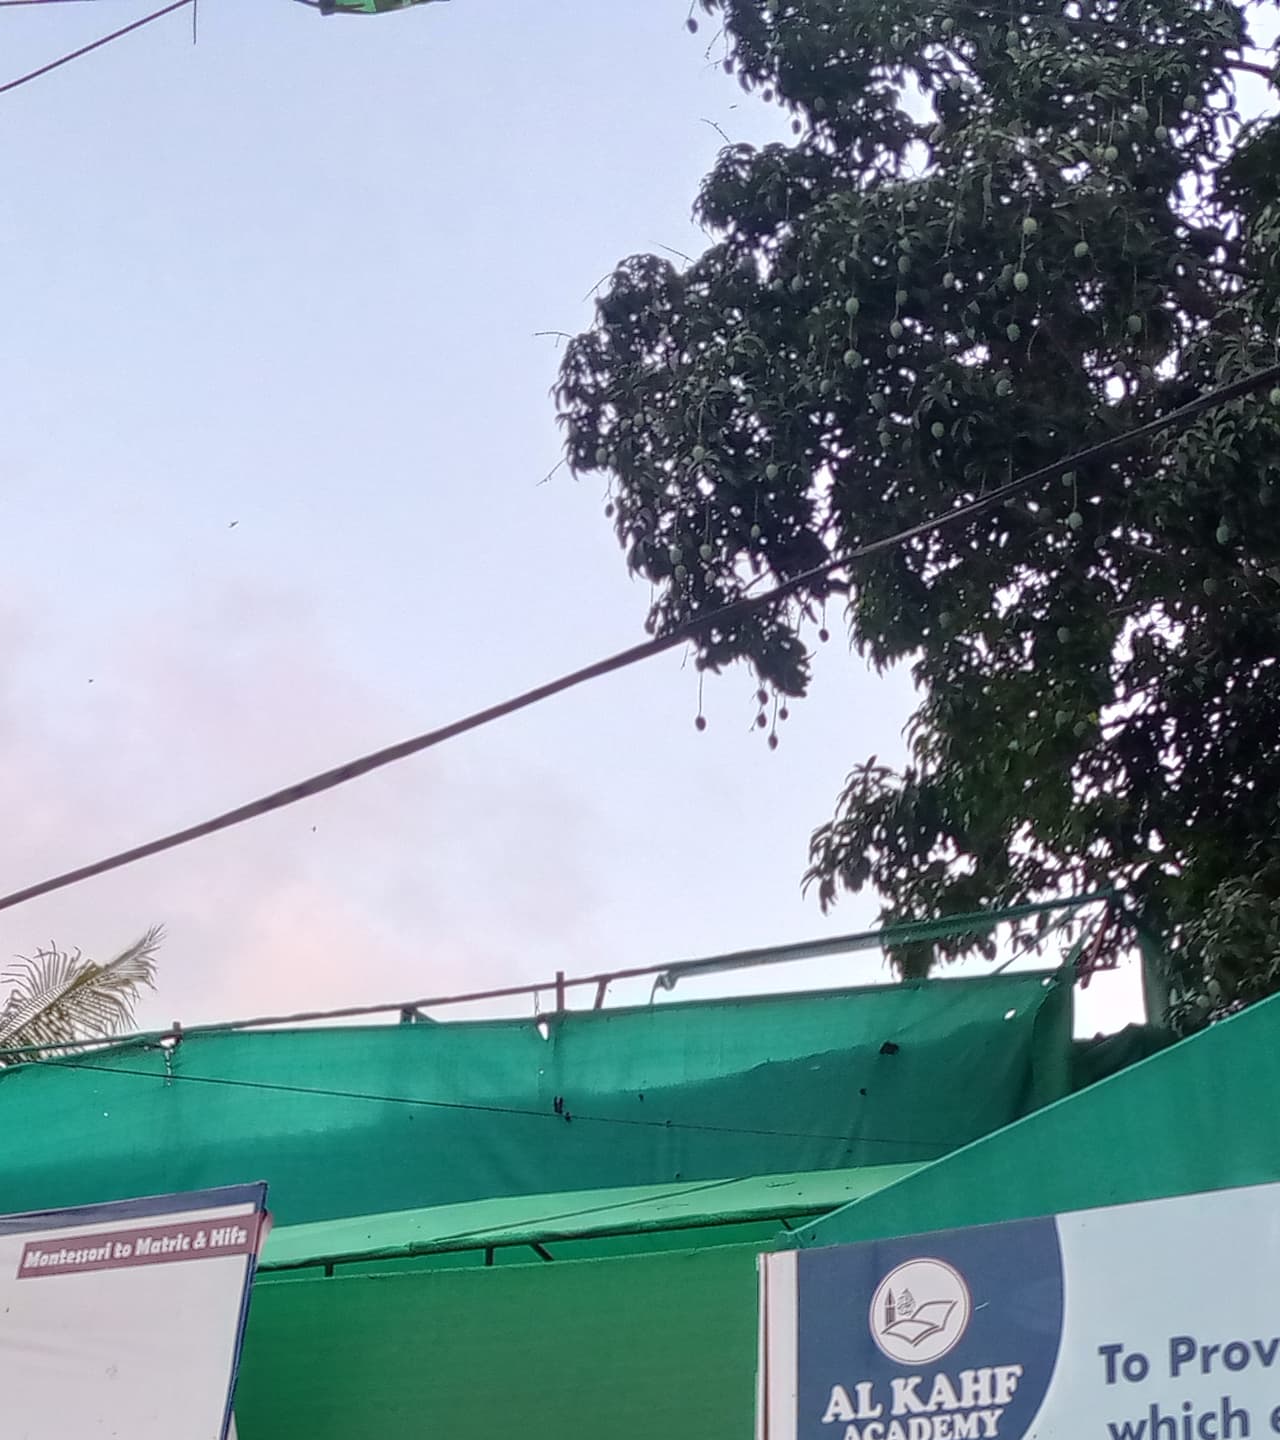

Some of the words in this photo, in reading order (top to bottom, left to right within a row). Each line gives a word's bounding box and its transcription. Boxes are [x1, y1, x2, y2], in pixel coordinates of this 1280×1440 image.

[22, 1242, 112, 1269] Montessori
[114, 1243, 132, 1258] to
[134, 1233, 191, 1256] Matric
[193, 1230, 207, 1249] &
[210, 1225, 248, 1248] Hifz
[1098, 1342, 1150, 1385] To
[821, 1381, 884, 1424] AL
[889, 1363, 1024, 1416] KAHF
